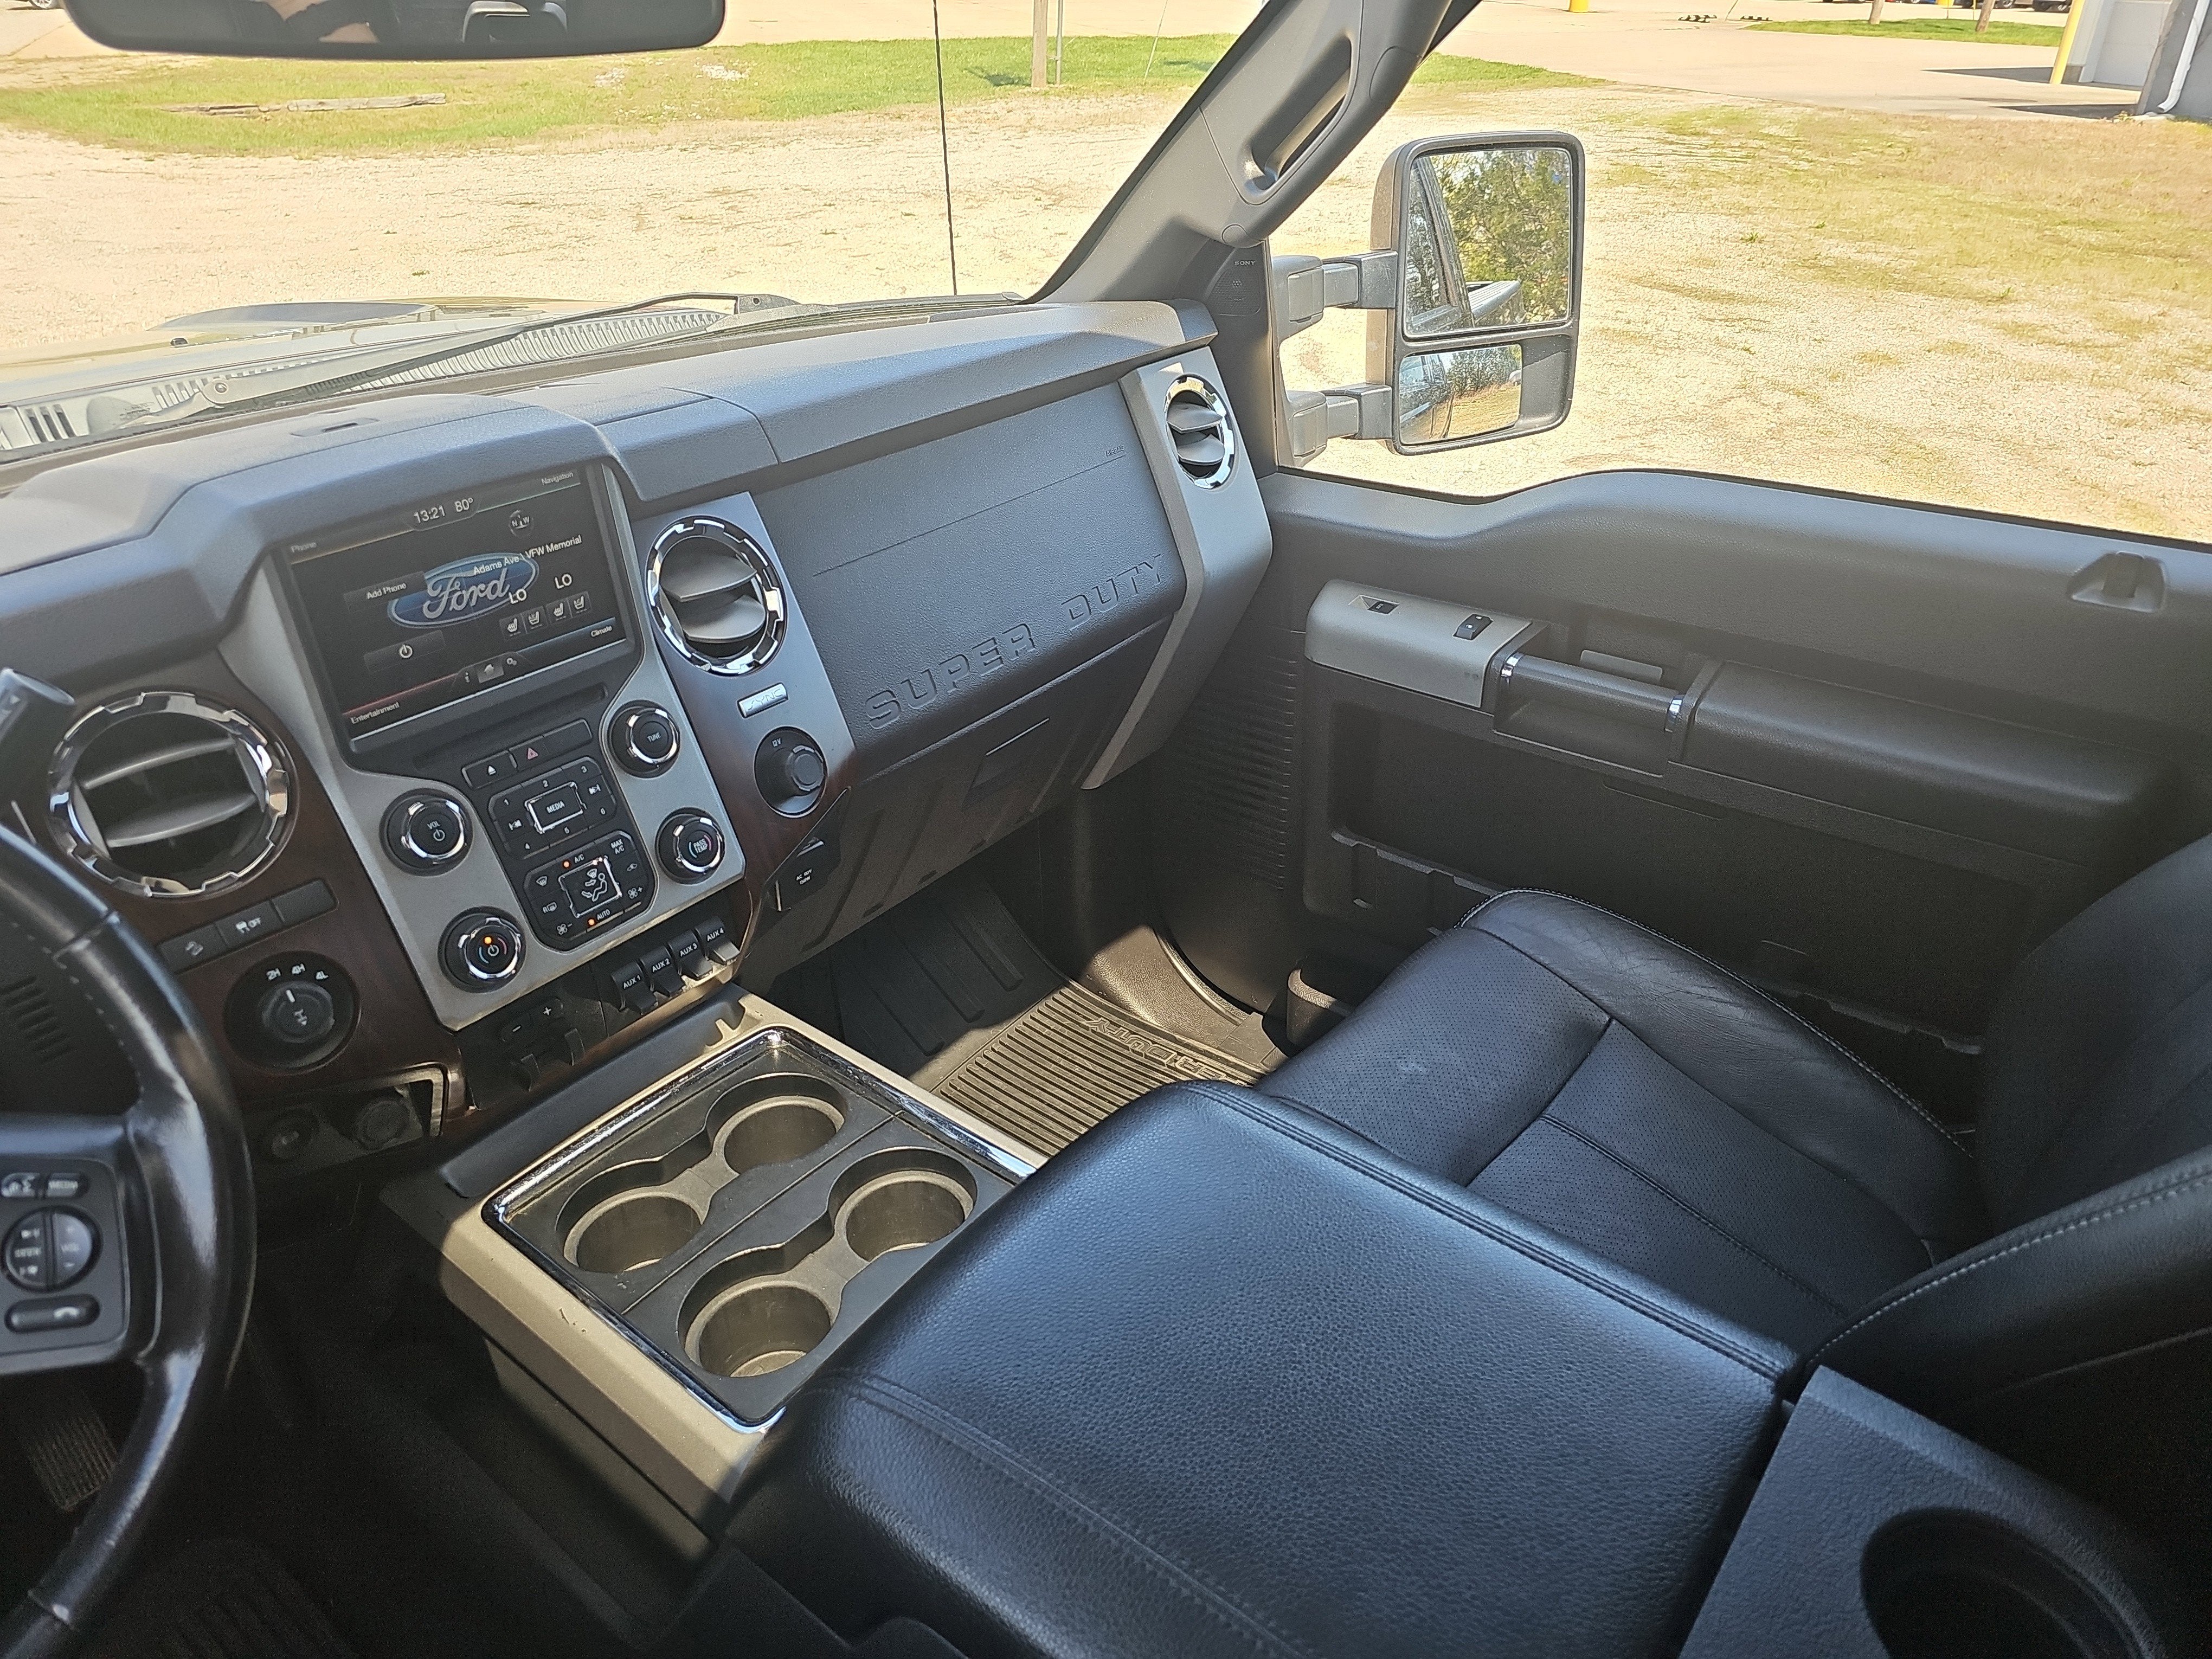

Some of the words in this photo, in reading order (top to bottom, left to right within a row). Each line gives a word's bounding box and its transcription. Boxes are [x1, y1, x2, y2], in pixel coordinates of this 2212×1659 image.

[1105, 445, 1125, 456] AIRBAG
[541, 471, 574, 485] Navigation
[413, 505, 446, 523] 13:21
[454, 497, 474, 512] 80°
[291, 541, 318, 552] Phone
[473, 562, 503, 576] Adams
[504, 556, 519, 567] Ave
[525, 546, 544, 558] VFW
[545, 535, 582, 554] Memorial
[555, 574, 572, 589] LO
[366, 589, 383, 600] Add
[383, 582, 407, 595] Phone
[422, 567, 511, 620] Ford
[509, 588, 527, 605] LO
[590, 626, 612, 637] Climate
[866, 622, 1036, 730] SUPER
[1061, 553, 1161, 631] DUTY
[748, 689, 782, 711] SYNC
[350, 702, 400, 724] Entertainment
[647, 732, 661, 742] TUNE
[546, 801, 565, 813] MEDIA
[427, 820, 440, 829] VOL
[610, 839, 623, 849] MAX
[693, 838, 705, 849] PASS
[615, 846, 625, 854] A/C
[574, 853, 584, 863] A/C
[597, 909, 610, 920] AUTO
[707, 930, 719, 942] AUX
[680, 946, 693, 957] AUX
[292, 963, 306, 974] 4H
[652, 961, 665, 973] AUX
[266, 968, 281, 981] 2H
[316, 970, 329, 980] 4L
[623, 978, 636, 989] AUX
[1083, 1017, 1178, 1064] DUTY
